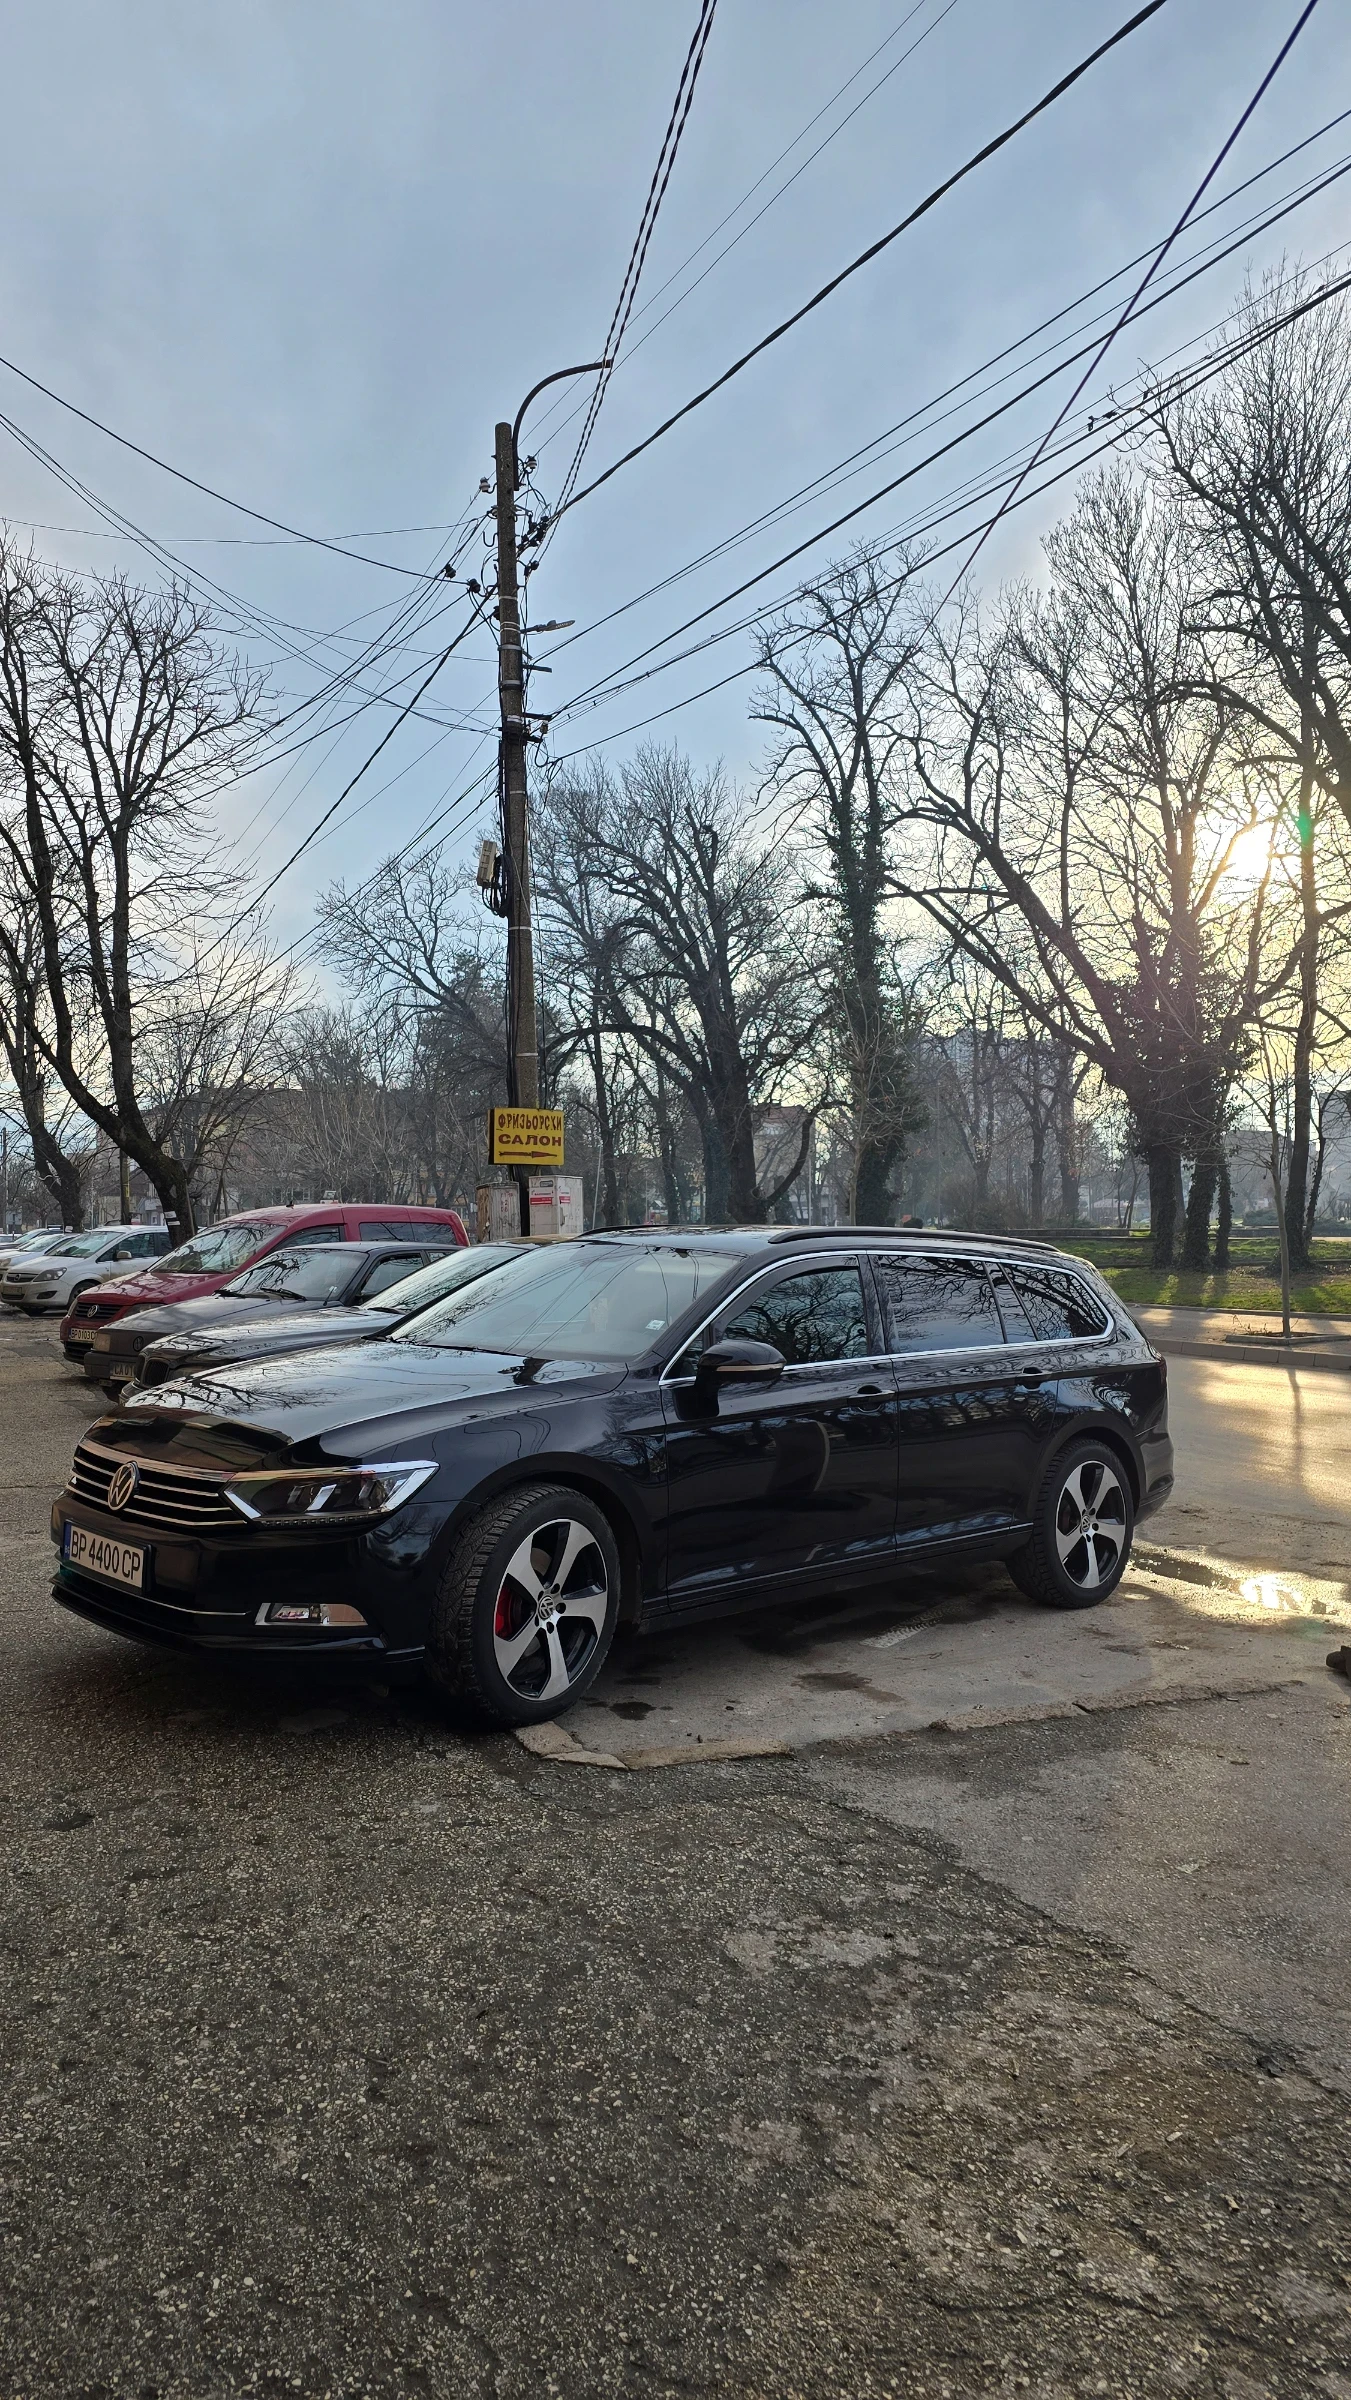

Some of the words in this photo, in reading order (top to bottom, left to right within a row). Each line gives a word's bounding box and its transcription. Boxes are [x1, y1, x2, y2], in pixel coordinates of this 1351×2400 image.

[498, 1133, 562, 1147] САЛОН
[71, 1530, 87, 1560] BP
[89, 1538, 120, 1574] 4400
[122, 1549, 141, 1580] CP
